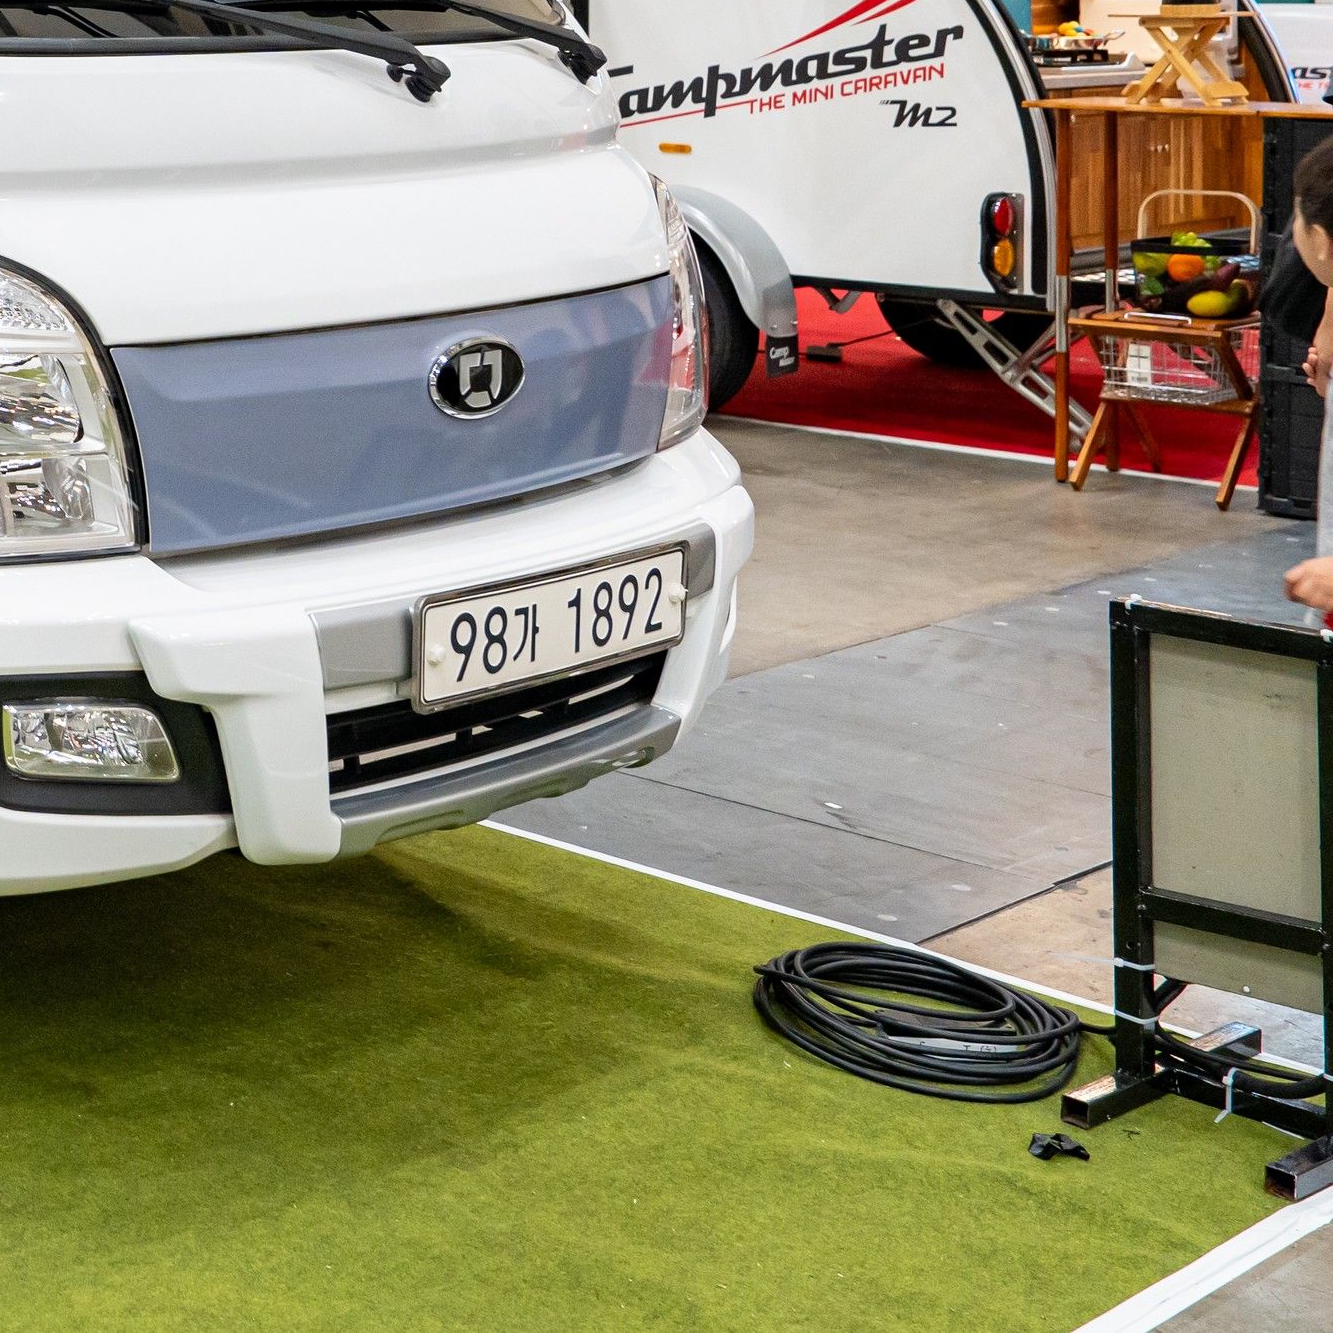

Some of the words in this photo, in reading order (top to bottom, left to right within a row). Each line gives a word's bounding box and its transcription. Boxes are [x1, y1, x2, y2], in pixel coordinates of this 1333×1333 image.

[609, 23, 965, 119] ampmaster
[747, 93, 786, 115] THE
[791, 83, 835, 107] MINI
[840, 62, 945, 97] CARAVAN
[450, 603, 539, 682] 98가
[567, 567, 663, 653] 1892
